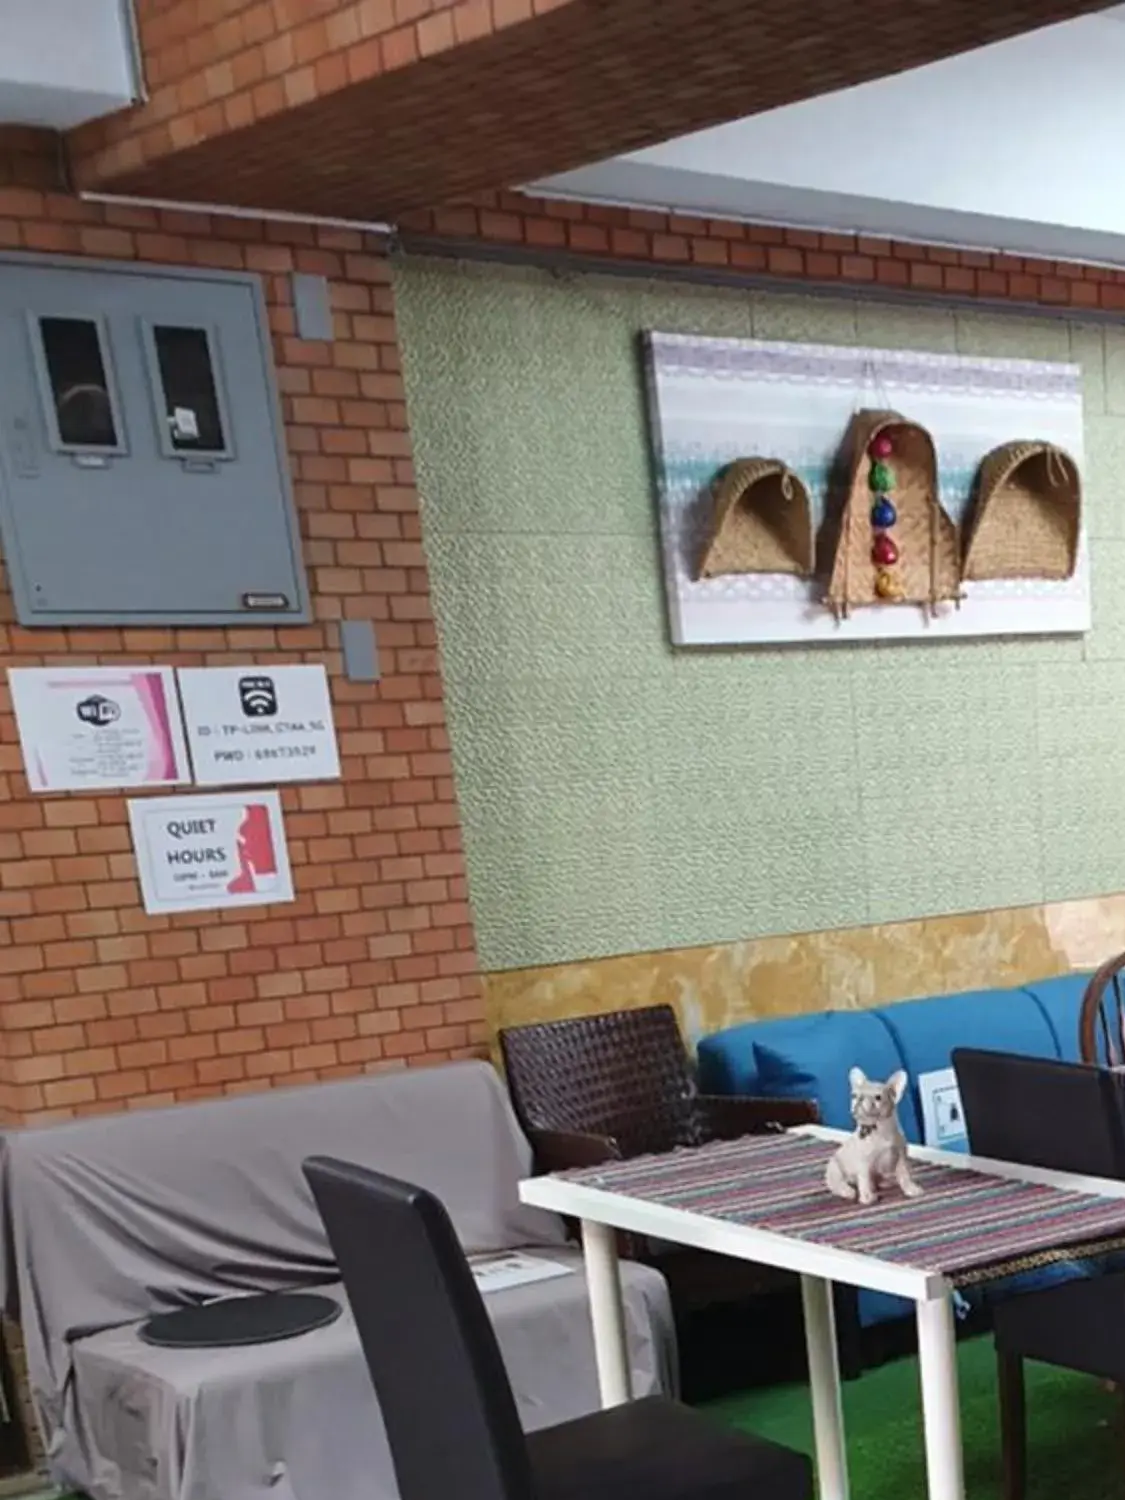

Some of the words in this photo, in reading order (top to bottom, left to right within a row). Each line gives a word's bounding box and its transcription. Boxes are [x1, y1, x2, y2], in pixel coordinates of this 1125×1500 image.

[214, 749, 244, 762] PWD
[166, 818, 216, 840] QUIET
[166, 847, 226, 864] HOURS
